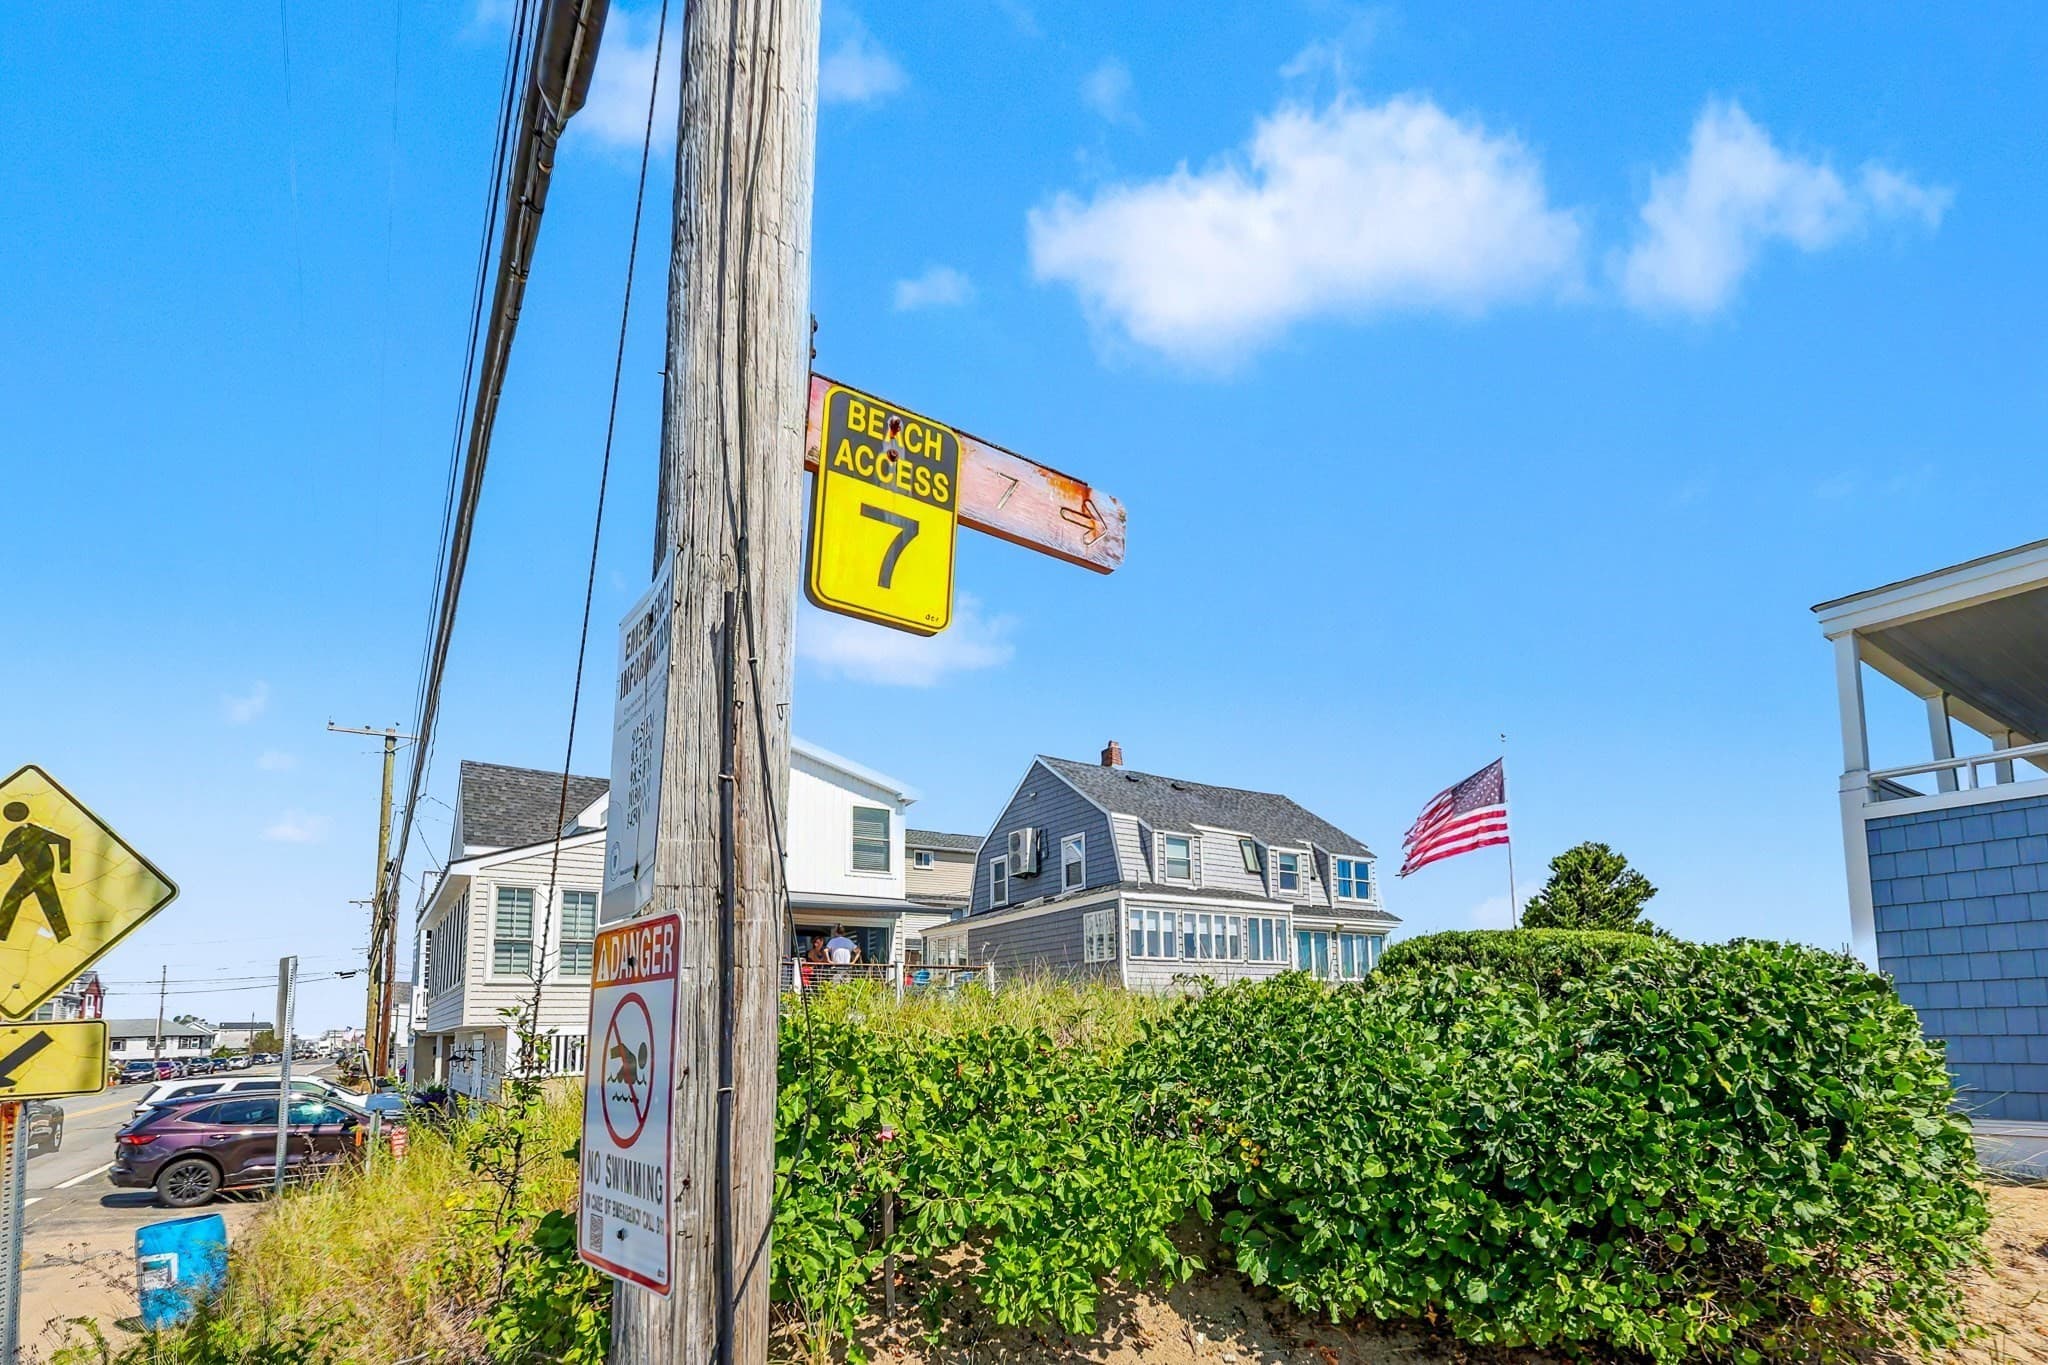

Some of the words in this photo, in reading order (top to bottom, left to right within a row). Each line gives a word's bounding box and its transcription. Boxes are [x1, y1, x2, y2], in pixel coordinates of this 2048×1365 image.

[834, 438, 949, 503] ACCESS
[996, 472, 1019, 509] 7
[860, 502, 919, 590] 7
[610, 922, 674, 981] DANGER
[586, 1149, 601, 1185] NO
[605, 1153, 663, 1206] SWIMMING
